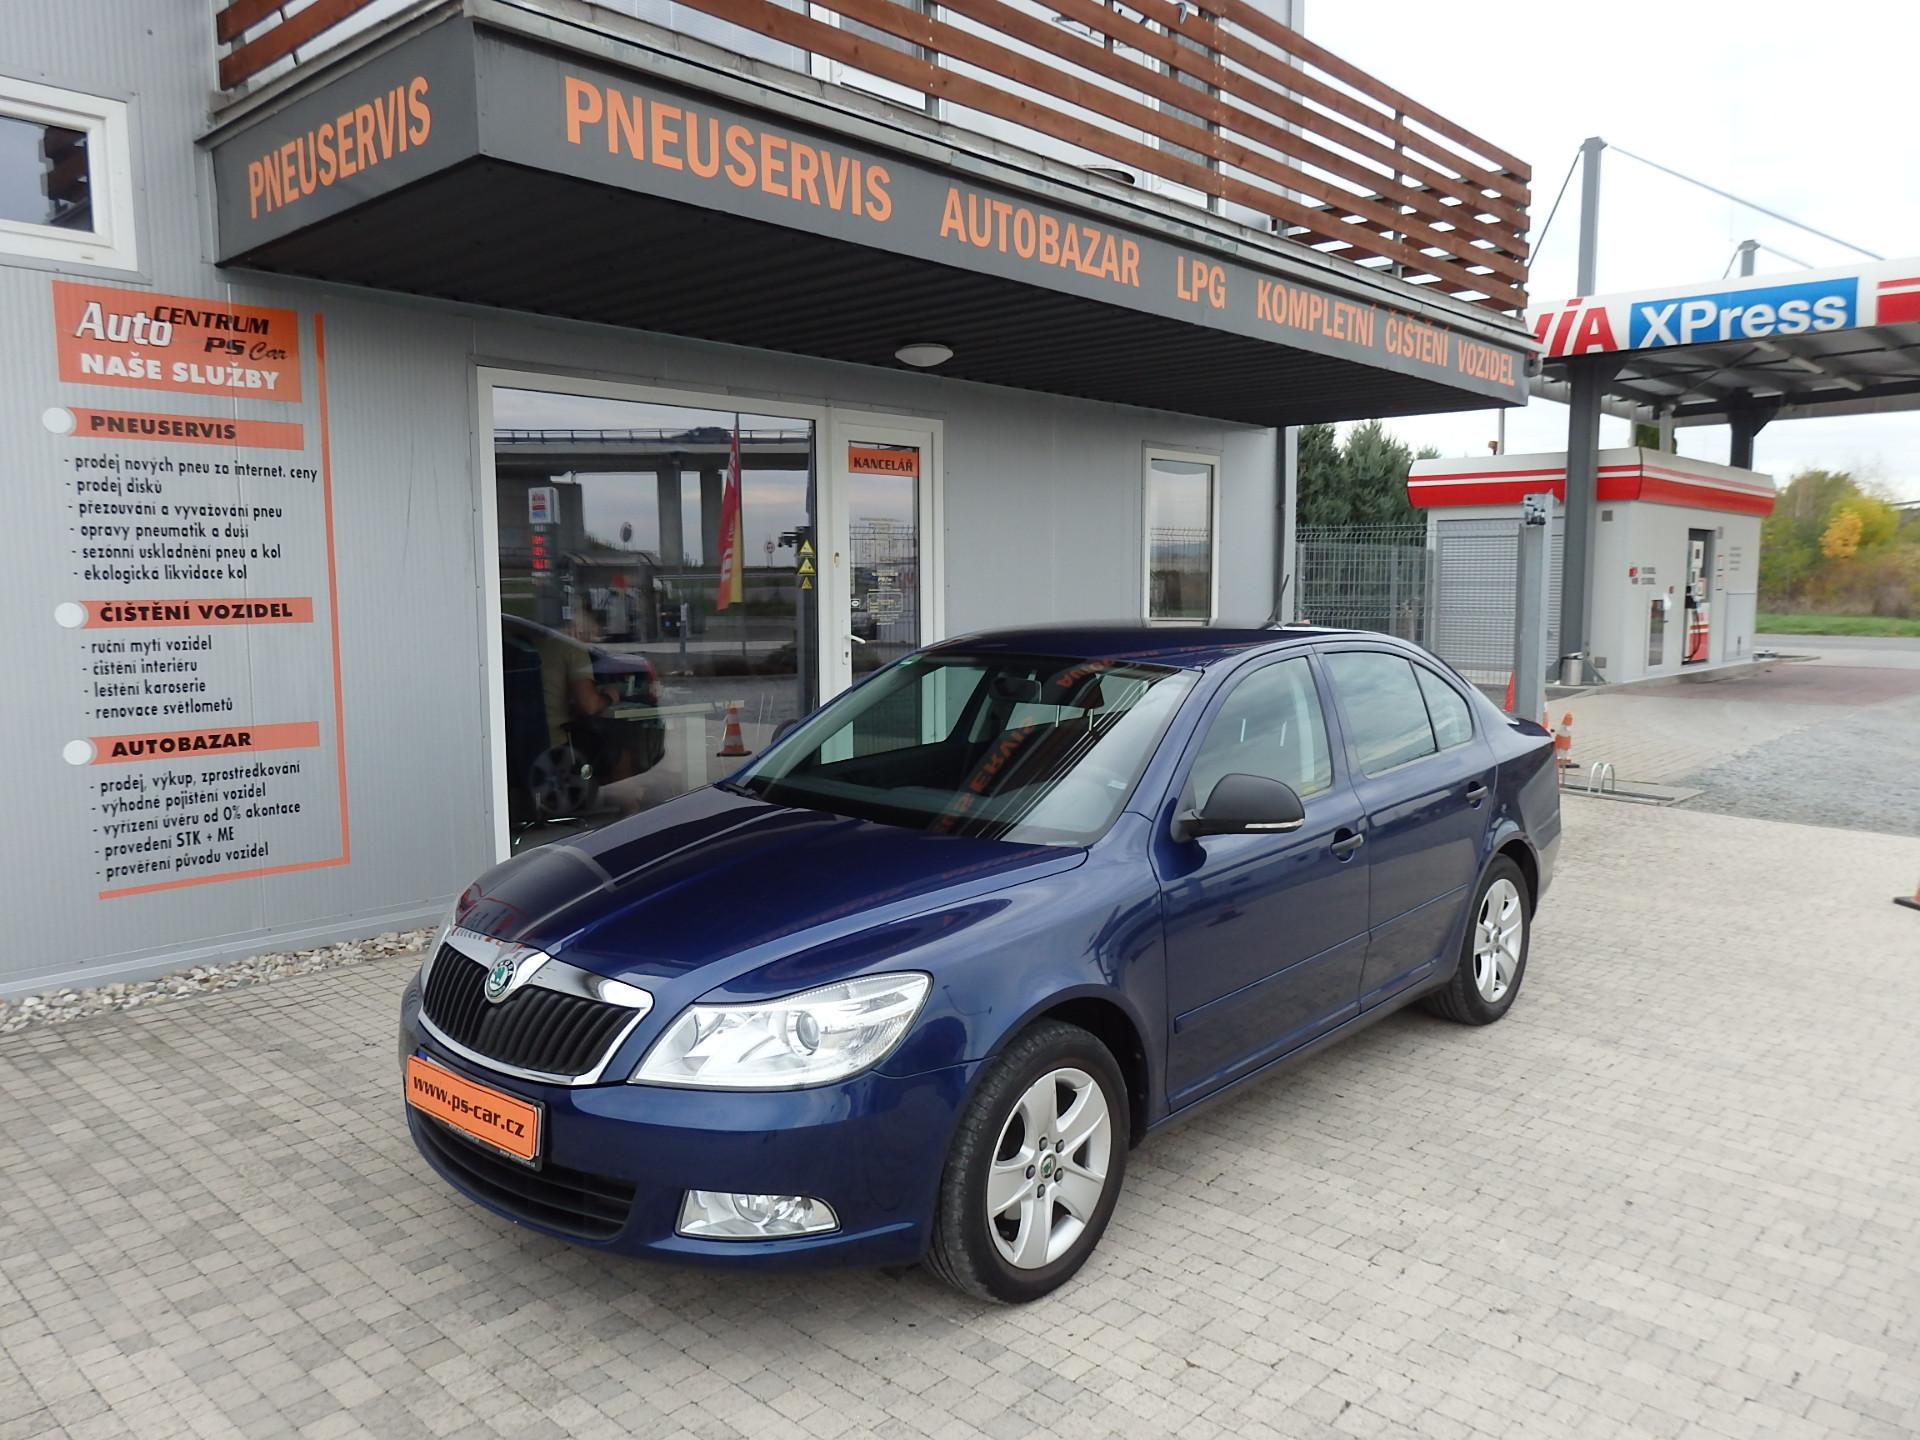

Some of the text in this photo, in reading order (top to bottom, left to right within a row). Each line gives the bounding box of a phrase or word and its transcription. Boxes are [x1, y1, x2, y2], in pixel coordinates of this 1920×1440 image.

[247, 76, 431, 219] PNEUSERVIS
[565, 76, 1515, 386] PNEUSERVIS AUTOBAZAR LPG KOMPLETNÍ ČIŠTĚNÍ VOZIDEL
[74, 301, 270, 347] Auto CENTRUM
[1638, 296, 1848, 349] XPress
[204, 337, 288, 361] PS Car
[80, 351, 280, 390] NAŠE SLUŽBY
[90, 415, 237, 440] PNEUSERVIS
[75, 453, 120, 474] prodej
[125, 456, 173, 475] nových
[178, 461, 210, 477] pneu
[214, 463, 229, 475] za
[290, 468, 318, 483] ceny
[853, 457, 913, 472] KANCELÁŘ
[77, 476, 121, 497] prodej
[161, 505, 169, 516] a
[253, 507, 283, 521] pneu
[80, 525, 130, 541] opravy
[135, 522, 207, 541] pneumatik
[211, 527, 219, 538] a
[215, 548, 246, 562] pneu
[250, 548, 258, 559] a
[262, 543, 281, 559] kol
[84, 563, 248, 584] ekologická likvidace kol
[100, 601, 293, 622] ČIŠTĚNÍ VOZIDEL
[166, 635, 212, 652] vozidel
[144, 678, 206, 695] karoserie
[95, 708, 159, 720] renovace
[111, 732, 252, 758] AUTOBAZAR
[223, 781, 266, 801] vozidel
[203, 807, 219, 824] od
[223, 804, 242, 821] 0%
[245, 803, 301, 819] akontace
[176, 830, 201, 848] STK
[217, 826, 235, 843] ME
[225, 841, 269, 861] vozidel
[413, 1076, 525, 1138] www.ps-car.cz
